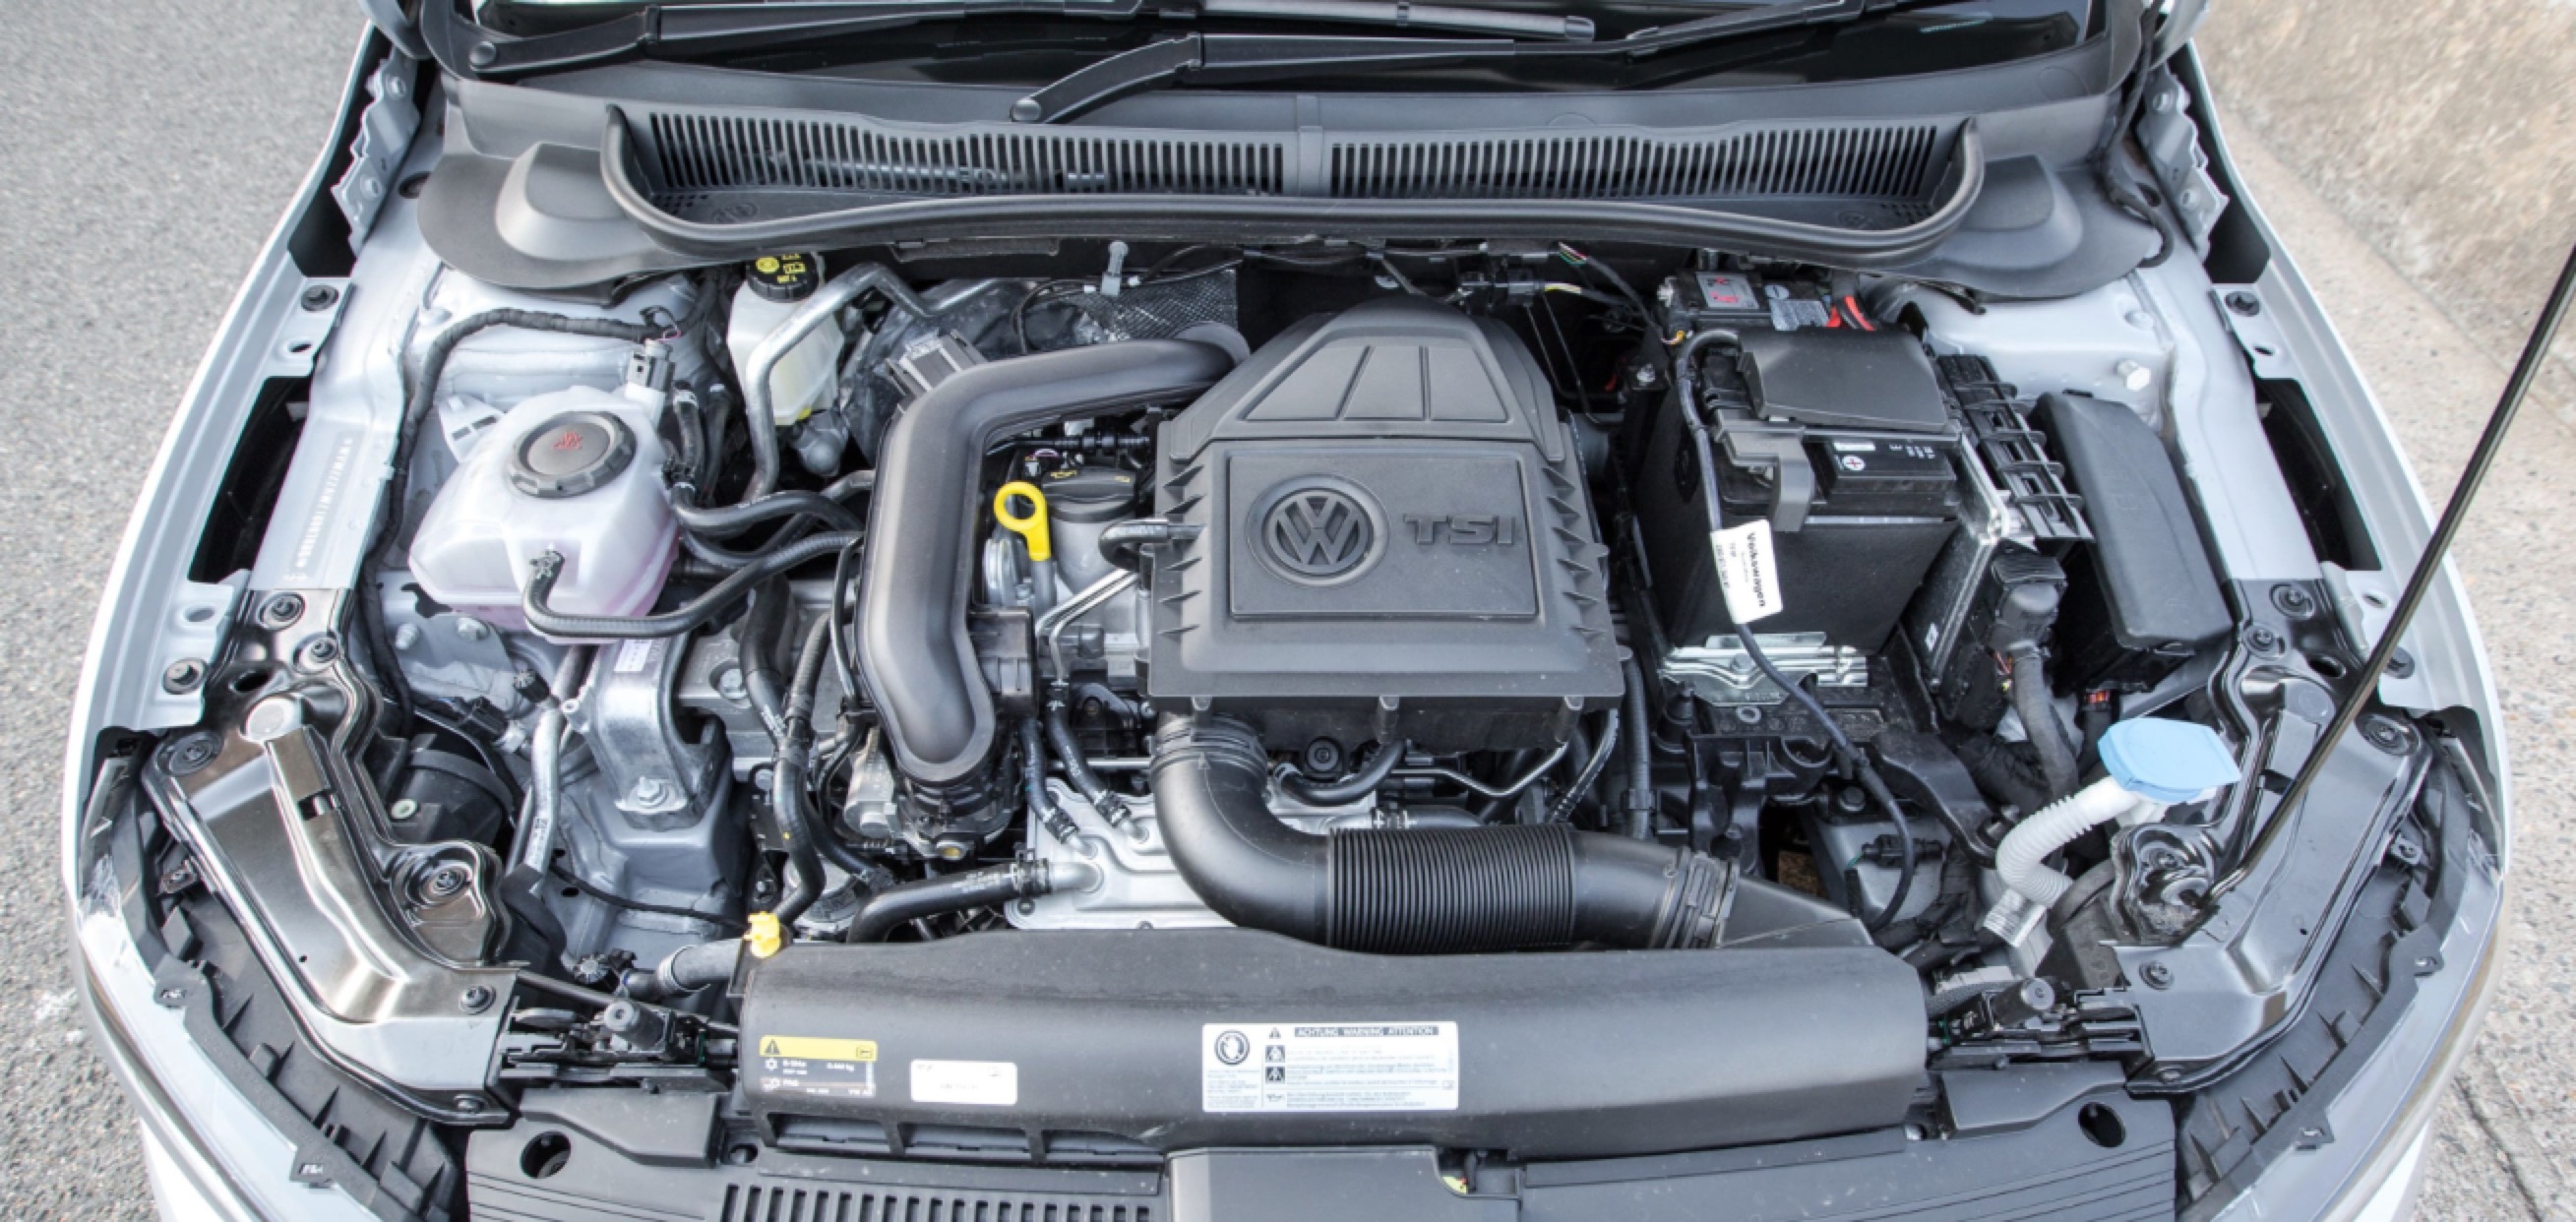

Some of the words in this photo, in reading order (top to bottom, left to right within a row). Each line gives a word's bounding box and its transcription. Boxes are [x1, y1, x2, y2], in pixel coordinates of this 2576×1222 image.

[1402, 514, 1515, 545] TSI
[1747, 531, 1766, 607] Volkswagen
[1297, 1027, 1338, 1037] ACHTUNG
[1343, 1027, 1383, 1037] WARNING
[1387, 1026, 1434, 1036] ATTENTION
